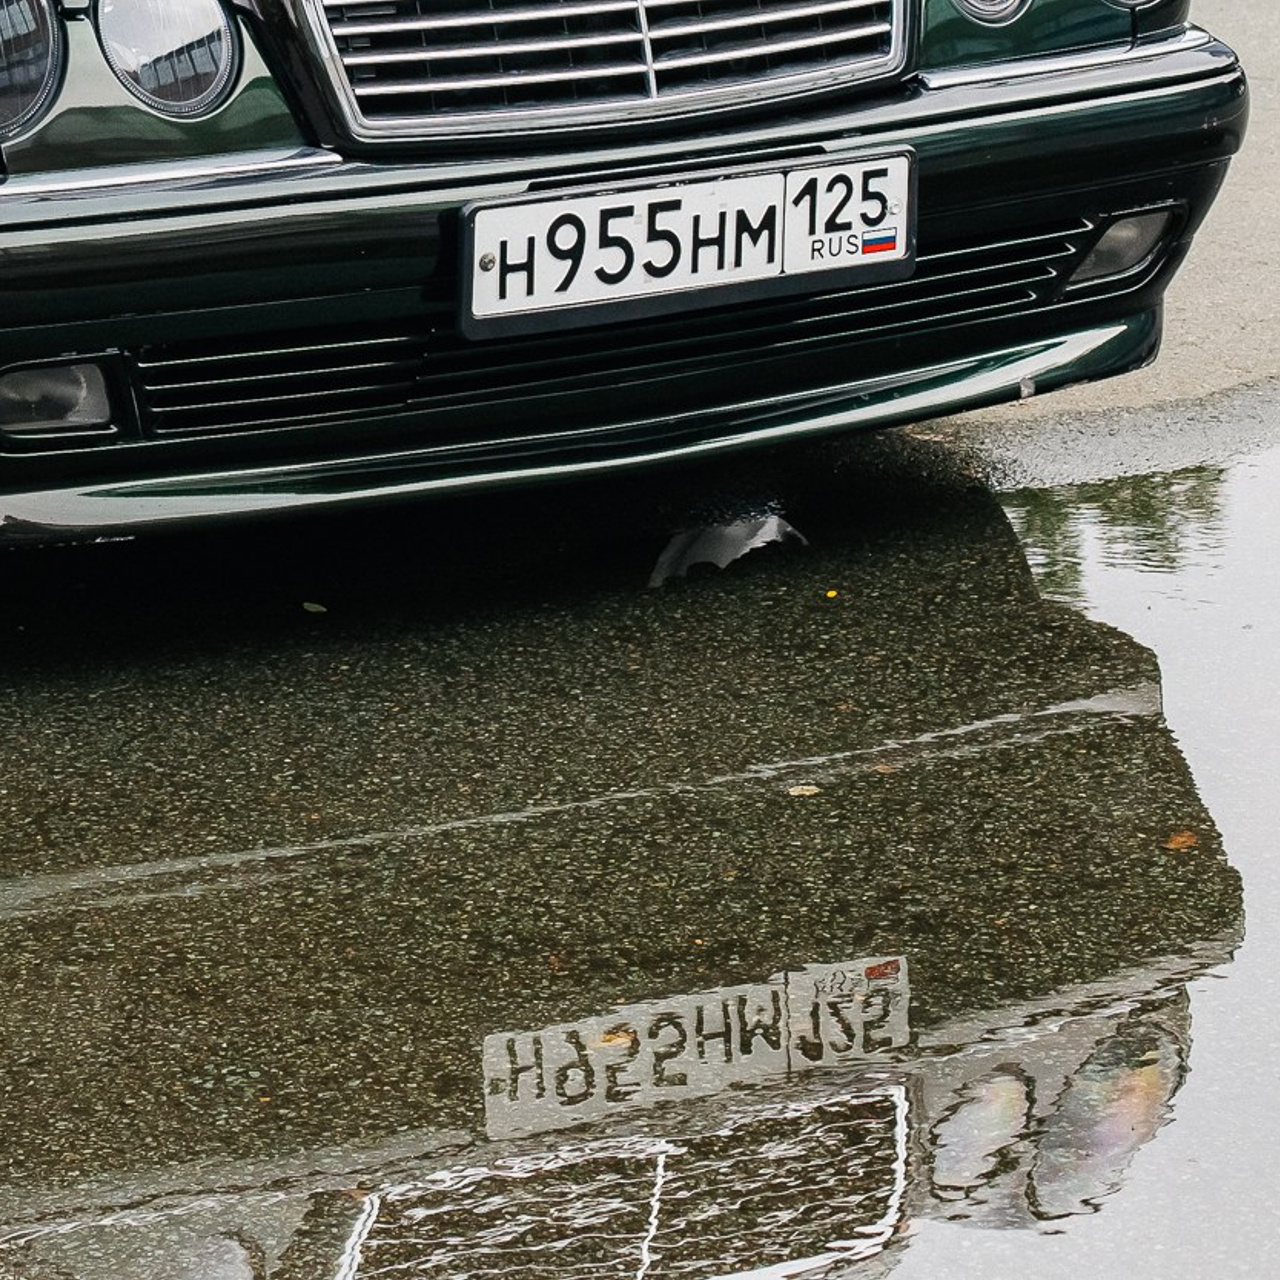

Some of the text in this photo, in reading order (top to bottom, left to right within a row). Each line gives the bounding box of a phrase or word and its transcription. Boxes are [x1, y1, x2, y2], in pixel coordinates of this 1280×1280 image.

[498, 167, 889, 301] Н955НМ 125
[810, 234, 860, 261] RUS
